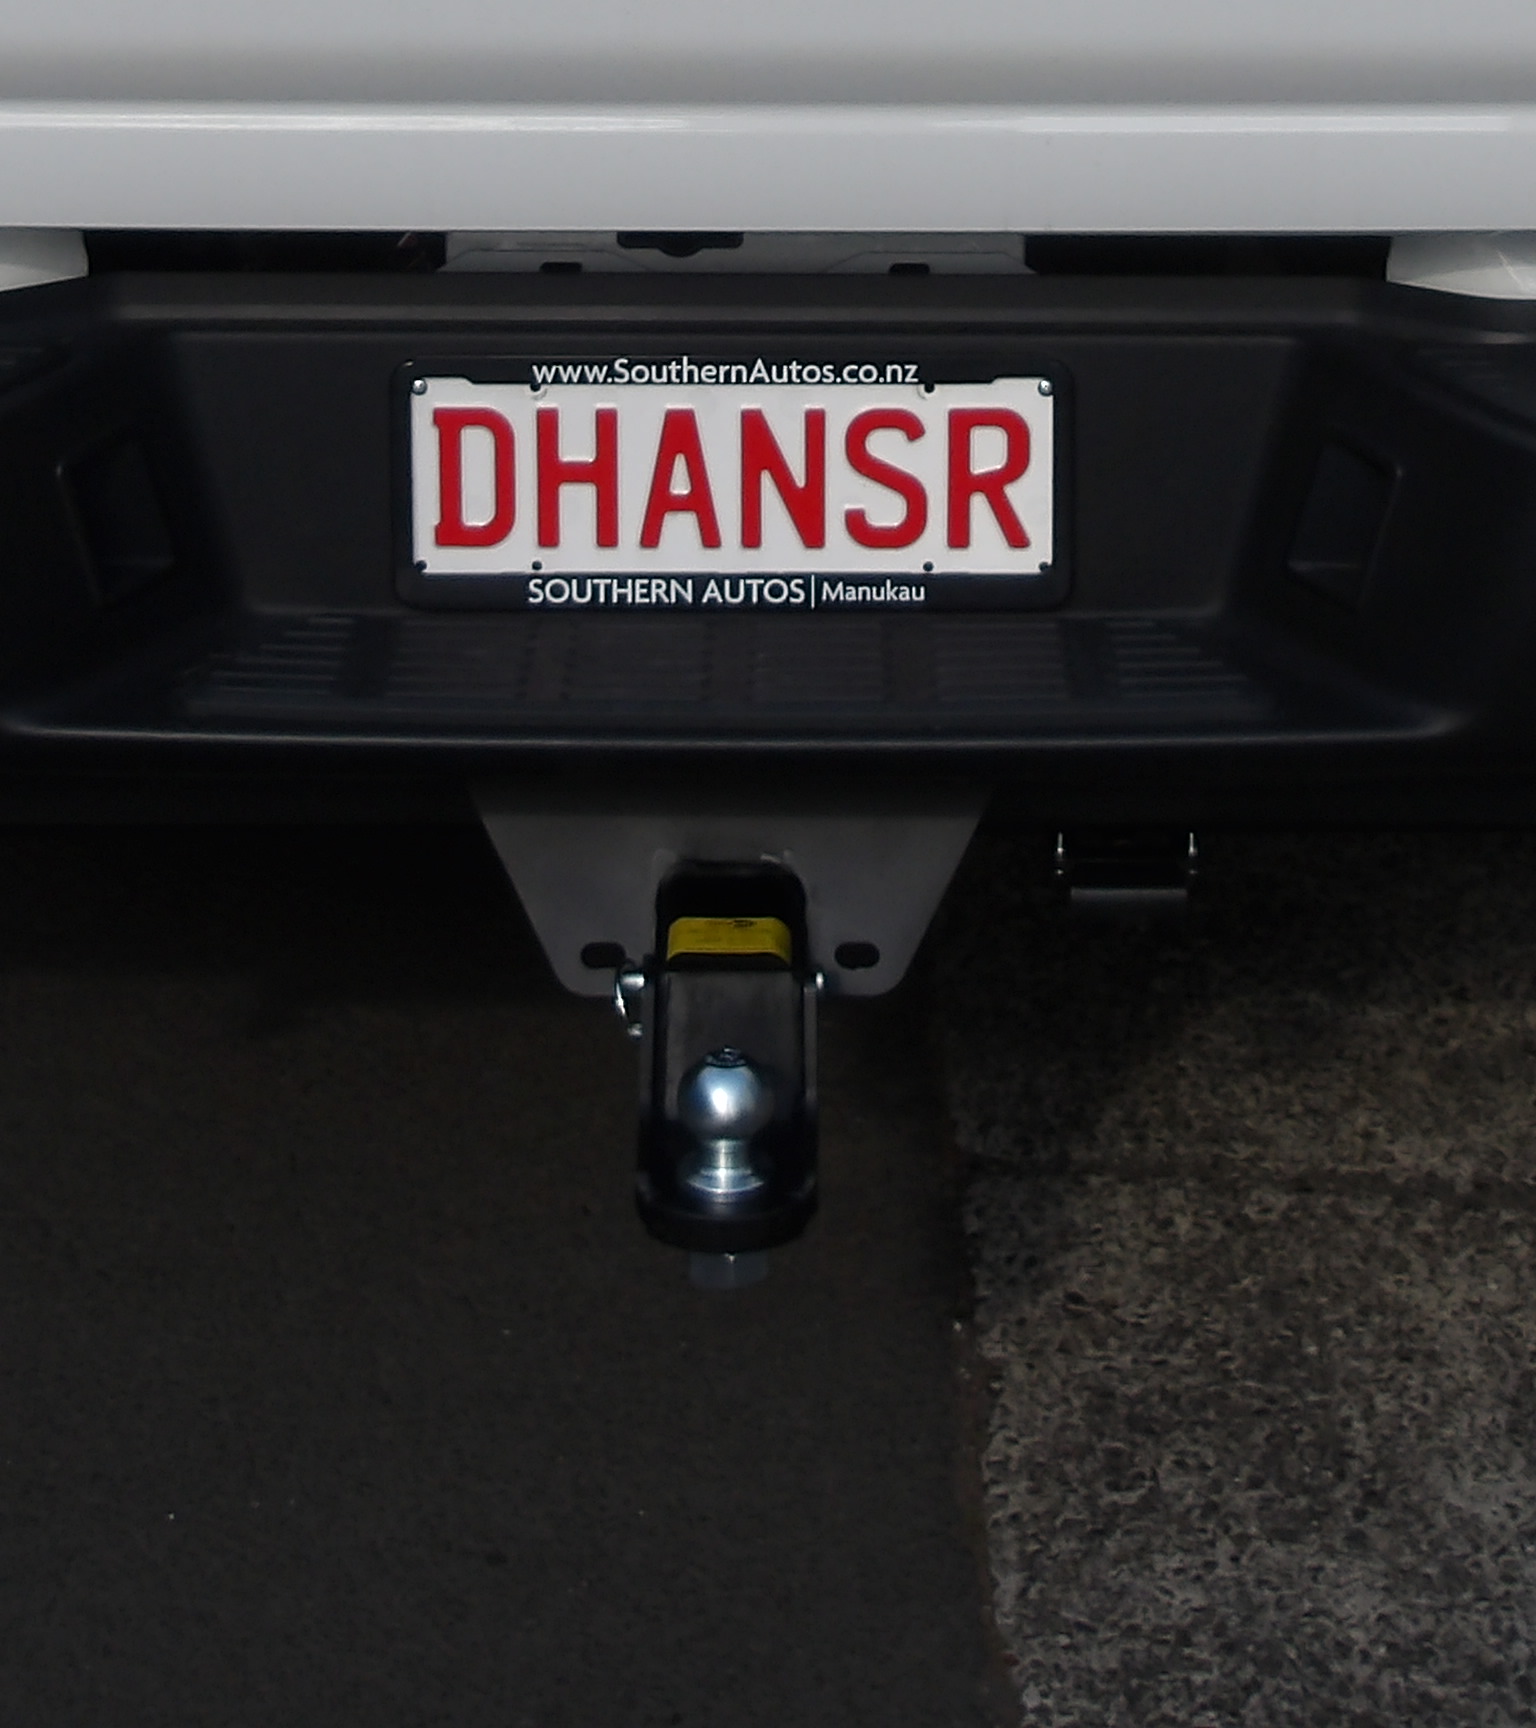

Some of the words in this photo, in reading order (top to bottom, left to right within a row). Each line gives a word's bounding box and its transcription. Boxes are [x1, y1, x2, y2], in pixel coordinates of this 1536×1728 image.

[532, 356, 920, 384] www.SouthernAutos.co.nz
[432, 406, 1032, 550] DHANSR
[527, 578, 695, 605] SOUTHERN
[702, 578, 806, 605] AUTOS
[821, 581, 926, 604] Manukau
